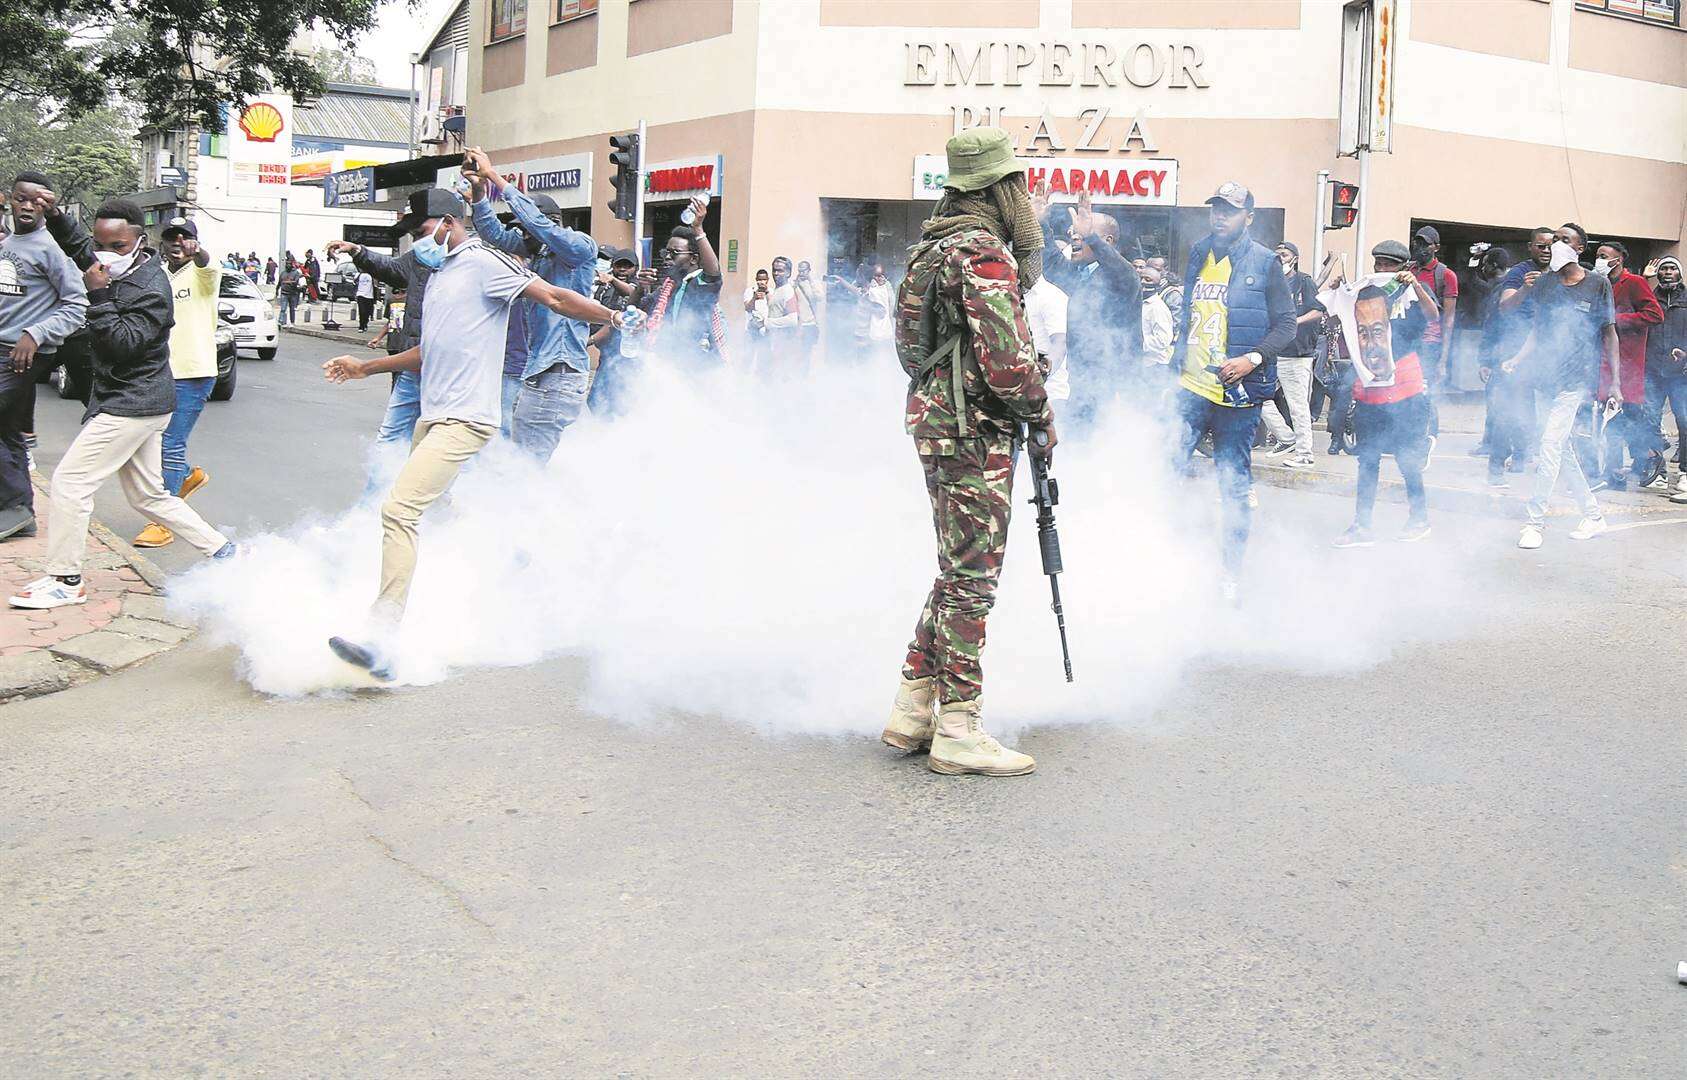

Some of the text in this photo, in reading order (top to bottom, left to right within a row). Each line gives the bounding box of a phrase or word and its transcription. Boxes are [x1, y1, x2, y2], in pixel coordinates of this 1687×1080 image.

[904, 42, 1210, 89] EMPEROR
[528, 170, 578, 190] OPTICIANS
[1028, 167, 1168, 197] HARMACY
[1187, 311, 1222, 349] 24
